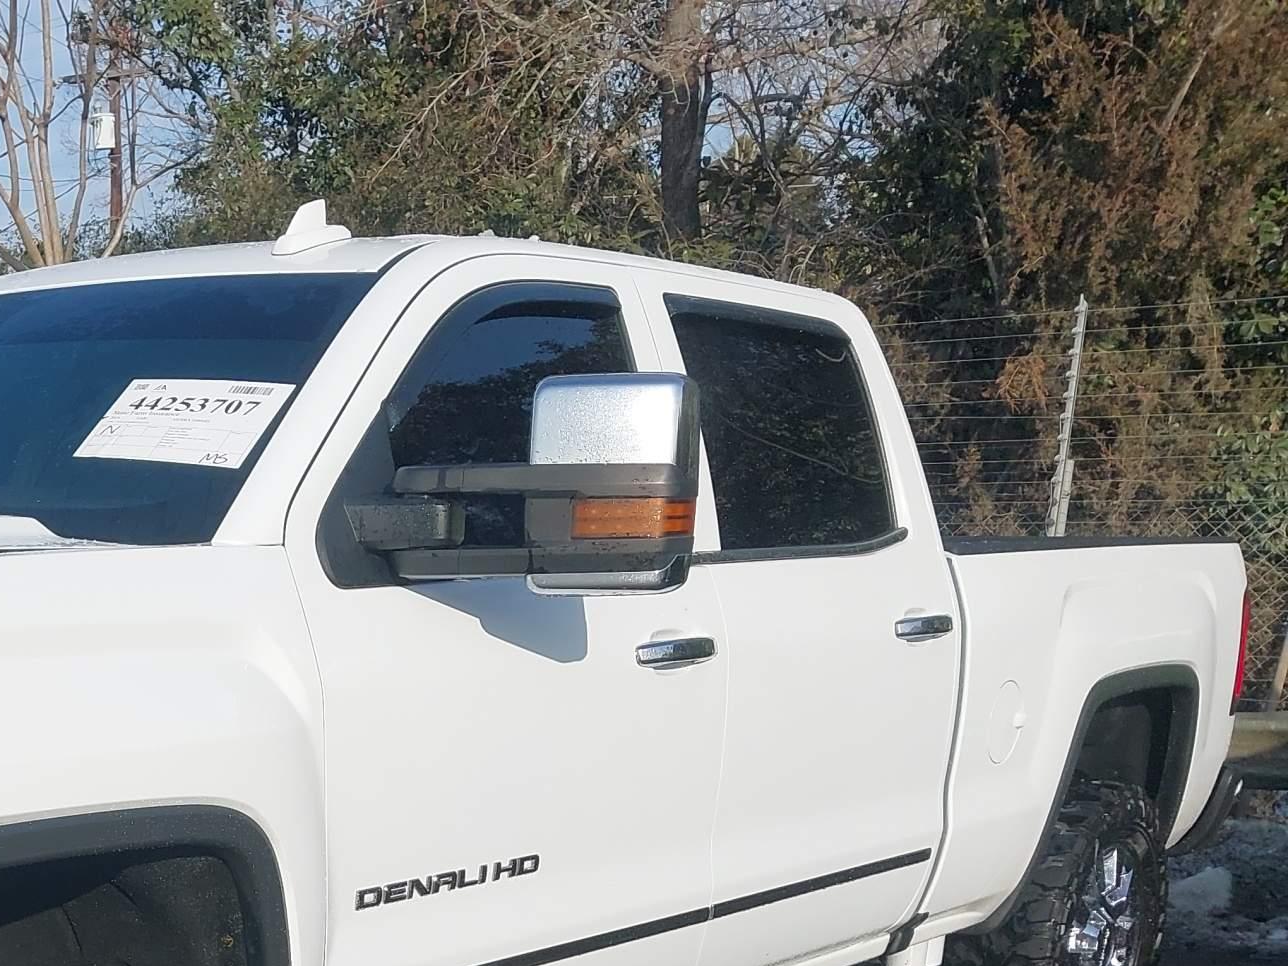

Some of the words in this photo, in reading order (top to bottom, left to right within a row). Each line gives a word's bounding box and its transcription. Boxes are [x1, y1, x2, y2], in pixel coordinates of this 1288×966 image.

[129, 396, 261, 416] 44253707
[355, 864, 488, 912] DENALI
[492, 854, 540, 882] HD
